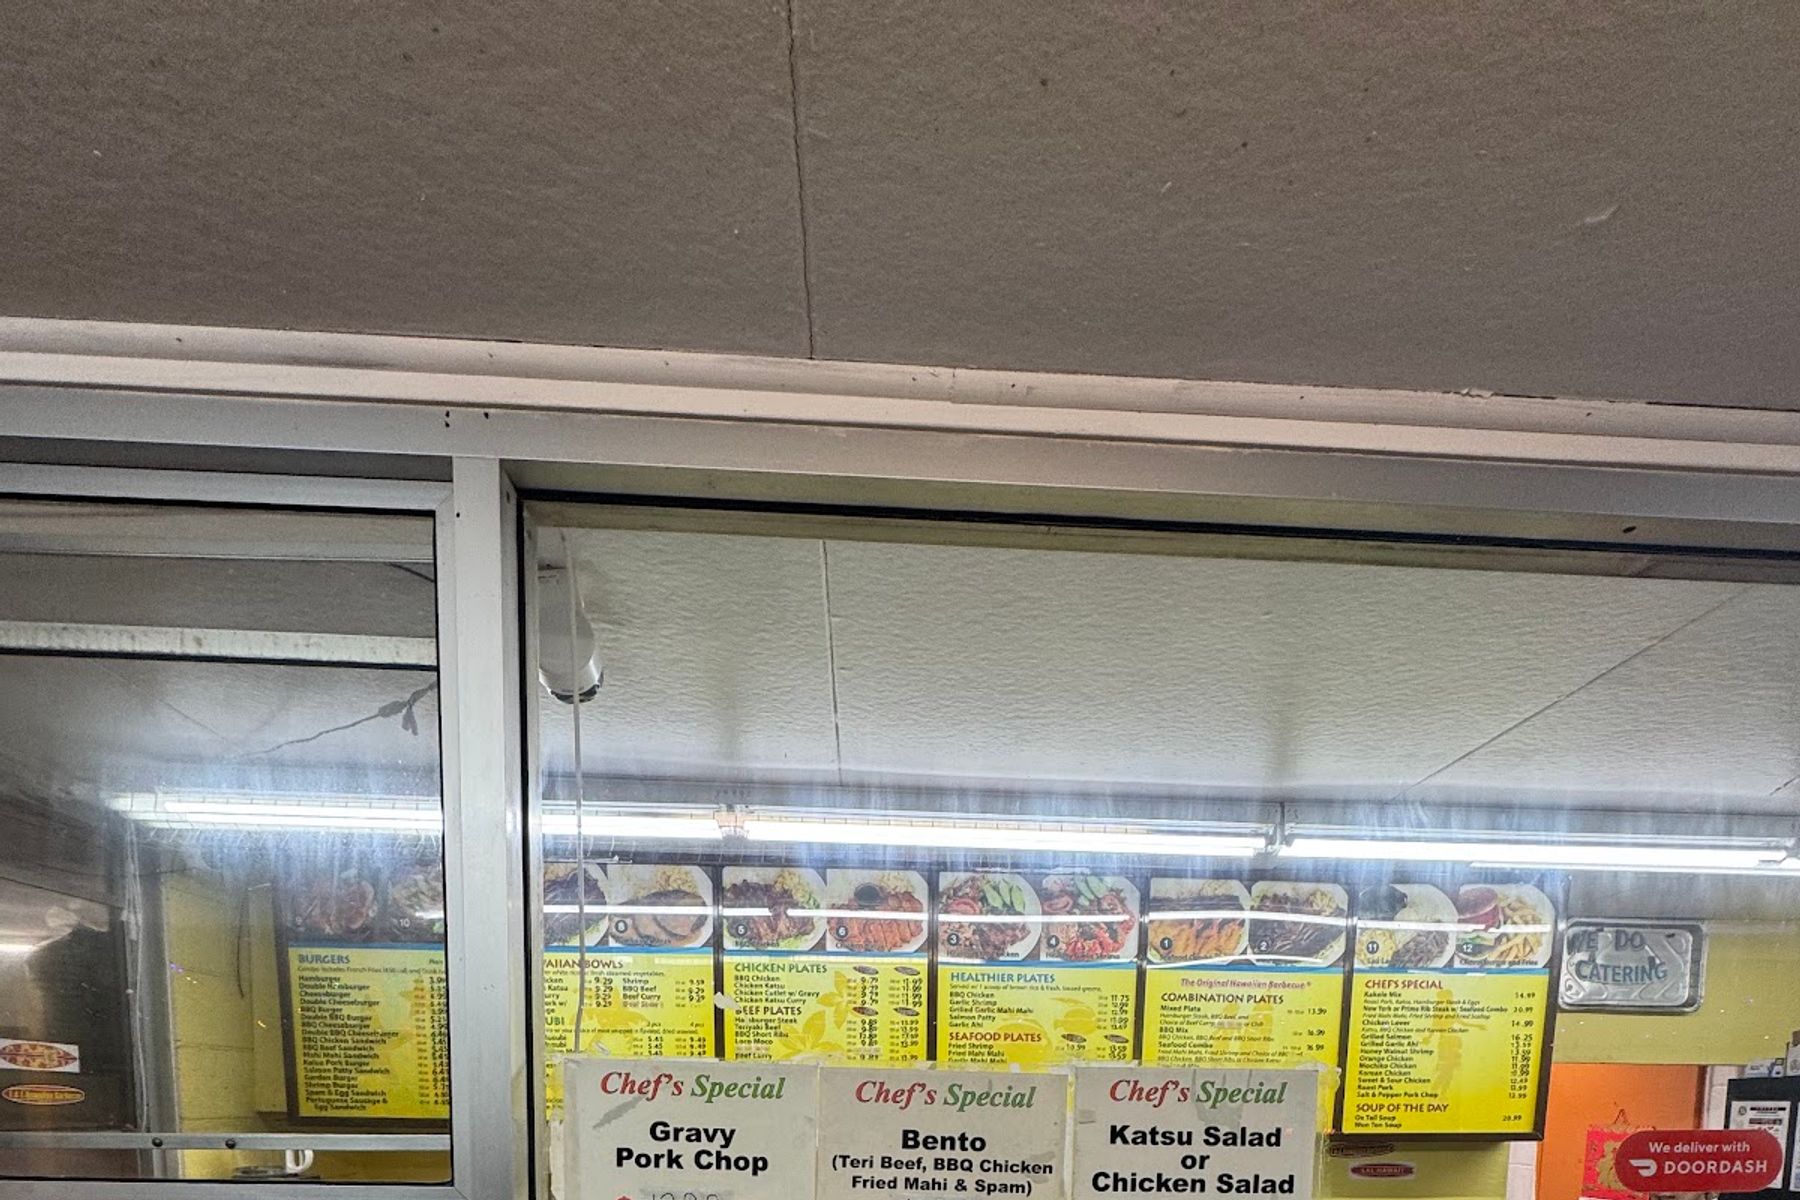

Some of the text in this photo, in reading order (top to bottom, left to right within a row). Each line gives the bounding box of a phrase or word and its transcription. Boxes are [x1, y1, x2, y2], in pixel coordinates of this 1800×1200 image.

[1614, 930, 1645, 951] DO
[298, 954, 350, 963] BURGERS
[734, 963, 827, 973] CHICKEN PLATES
[951, 973, 1055, 983] HEALTHIER PLATES
[1575, 959, 1668, 983] CATERING
[1401, 980, 1443, 989] SPECIAL
[1161, 993, 1284, 1004] COMBINATION PLATES
[764, 1007, 802, 1016] PLATES
[949, 1032, 1042, 1042] SEAFOOD PLATES
[600, 1071, 786, 1102] Chef's Special
[1110, 1079, 1288, 1109] Chef's Special
[856, 1081, 1037, 1112] Chef's Special
[1356, 1104, 1449, 1112] SOUP OF THE DAY
[649, 1121, 736, 1148] Gravy
[902, 1130, 986, 1152] Bento
[1110, 1125, 1282, 1147] Katsu Salad
[1649, 1141, 1750, 1153] We deliver with
[616, 1148, 769, 1176] Pork Chop
[832, 1155, 1053, 1174] (Teri Beef, BBQ Chicken
[1181, 1155, 1210, 1170] or
[1664, 1160, 1767, 1174] DOORDASH
[852, 1176, 1032, 1197] Fried Mahi & Spam)
[1092, 1172, 1295, 1194] Chicken Salad
